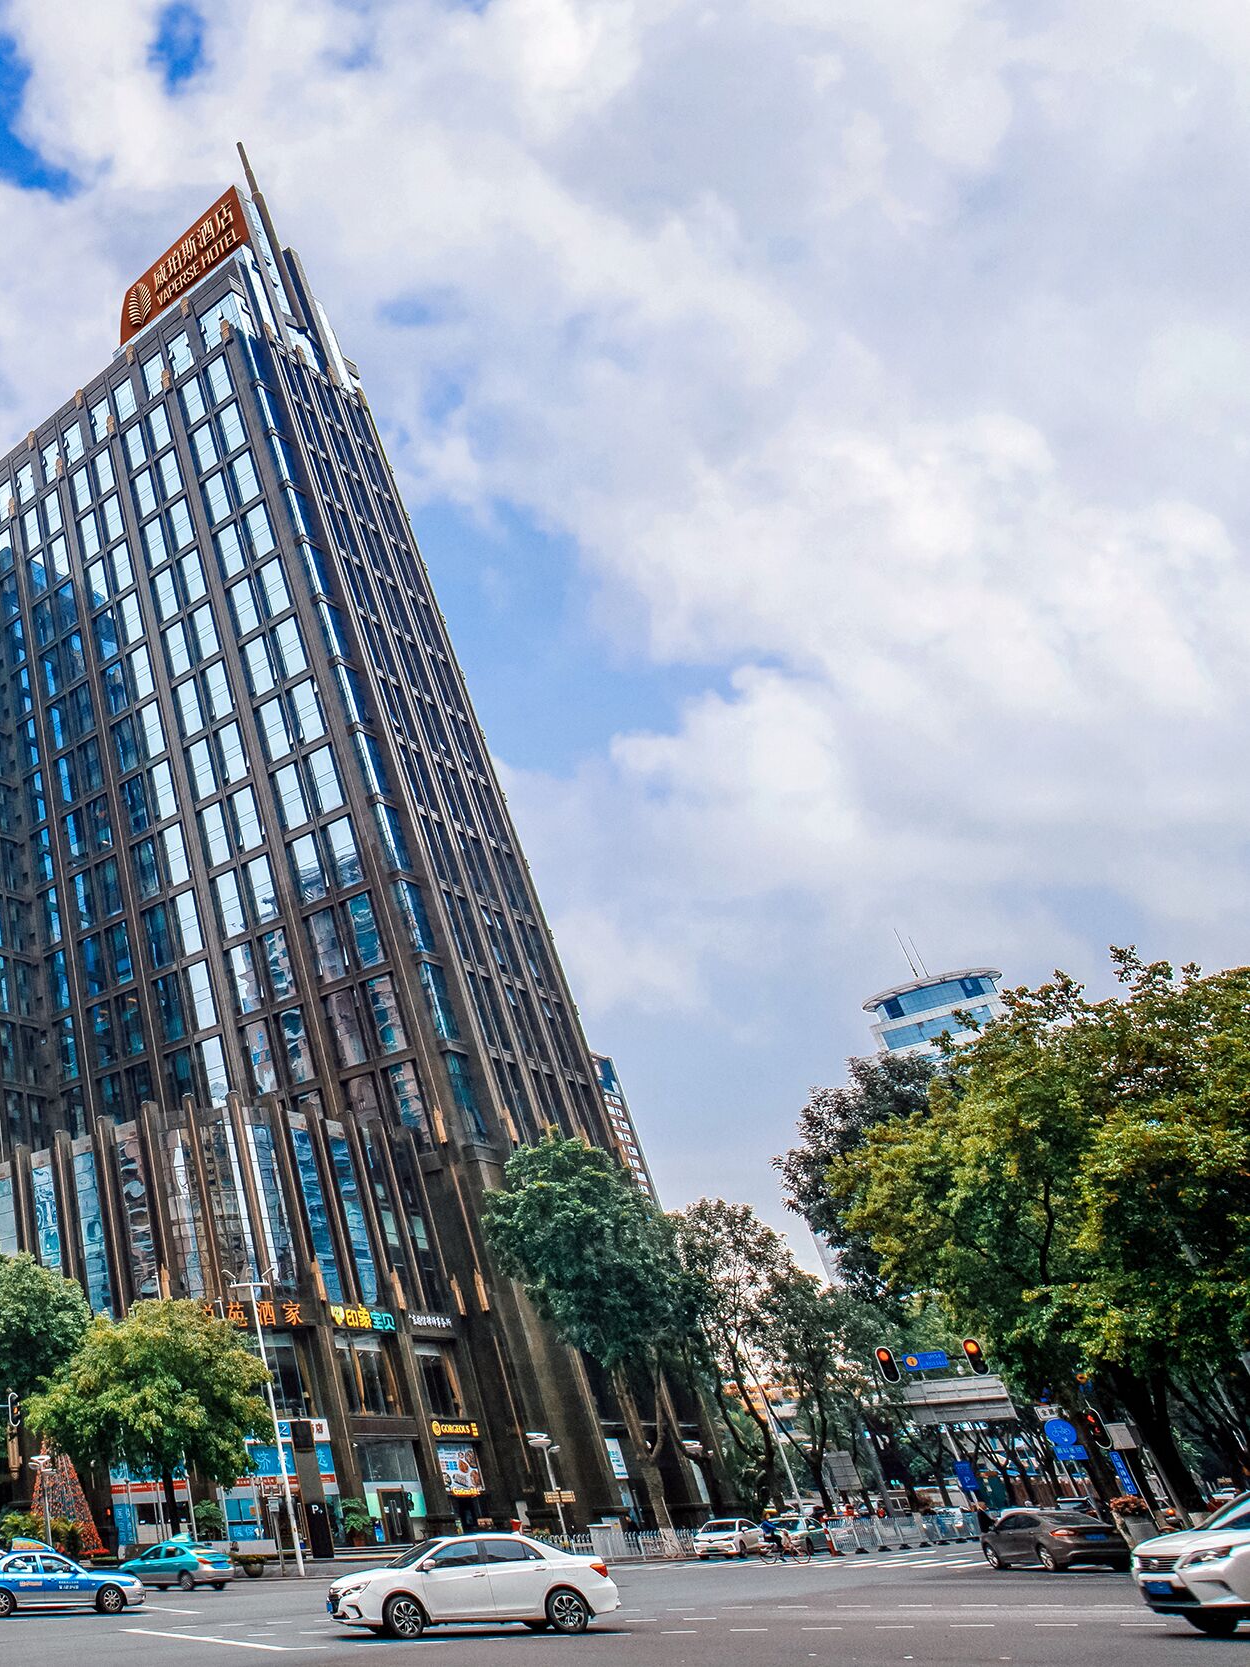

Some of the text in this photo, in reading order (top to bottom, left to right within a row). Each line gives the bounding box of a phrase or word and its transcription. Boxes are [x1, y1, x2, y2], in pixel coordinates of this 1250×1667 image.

[154, 199, 234, 292] 威珀斯酒店
[156, 228, 242, 306] VAPERSE HOTEL
[345, 1303, 396, 1331] 印象宝贝
[440, 1424, 471, 1434] GORGEOUS
[311, 1504, 319, 1514] P
